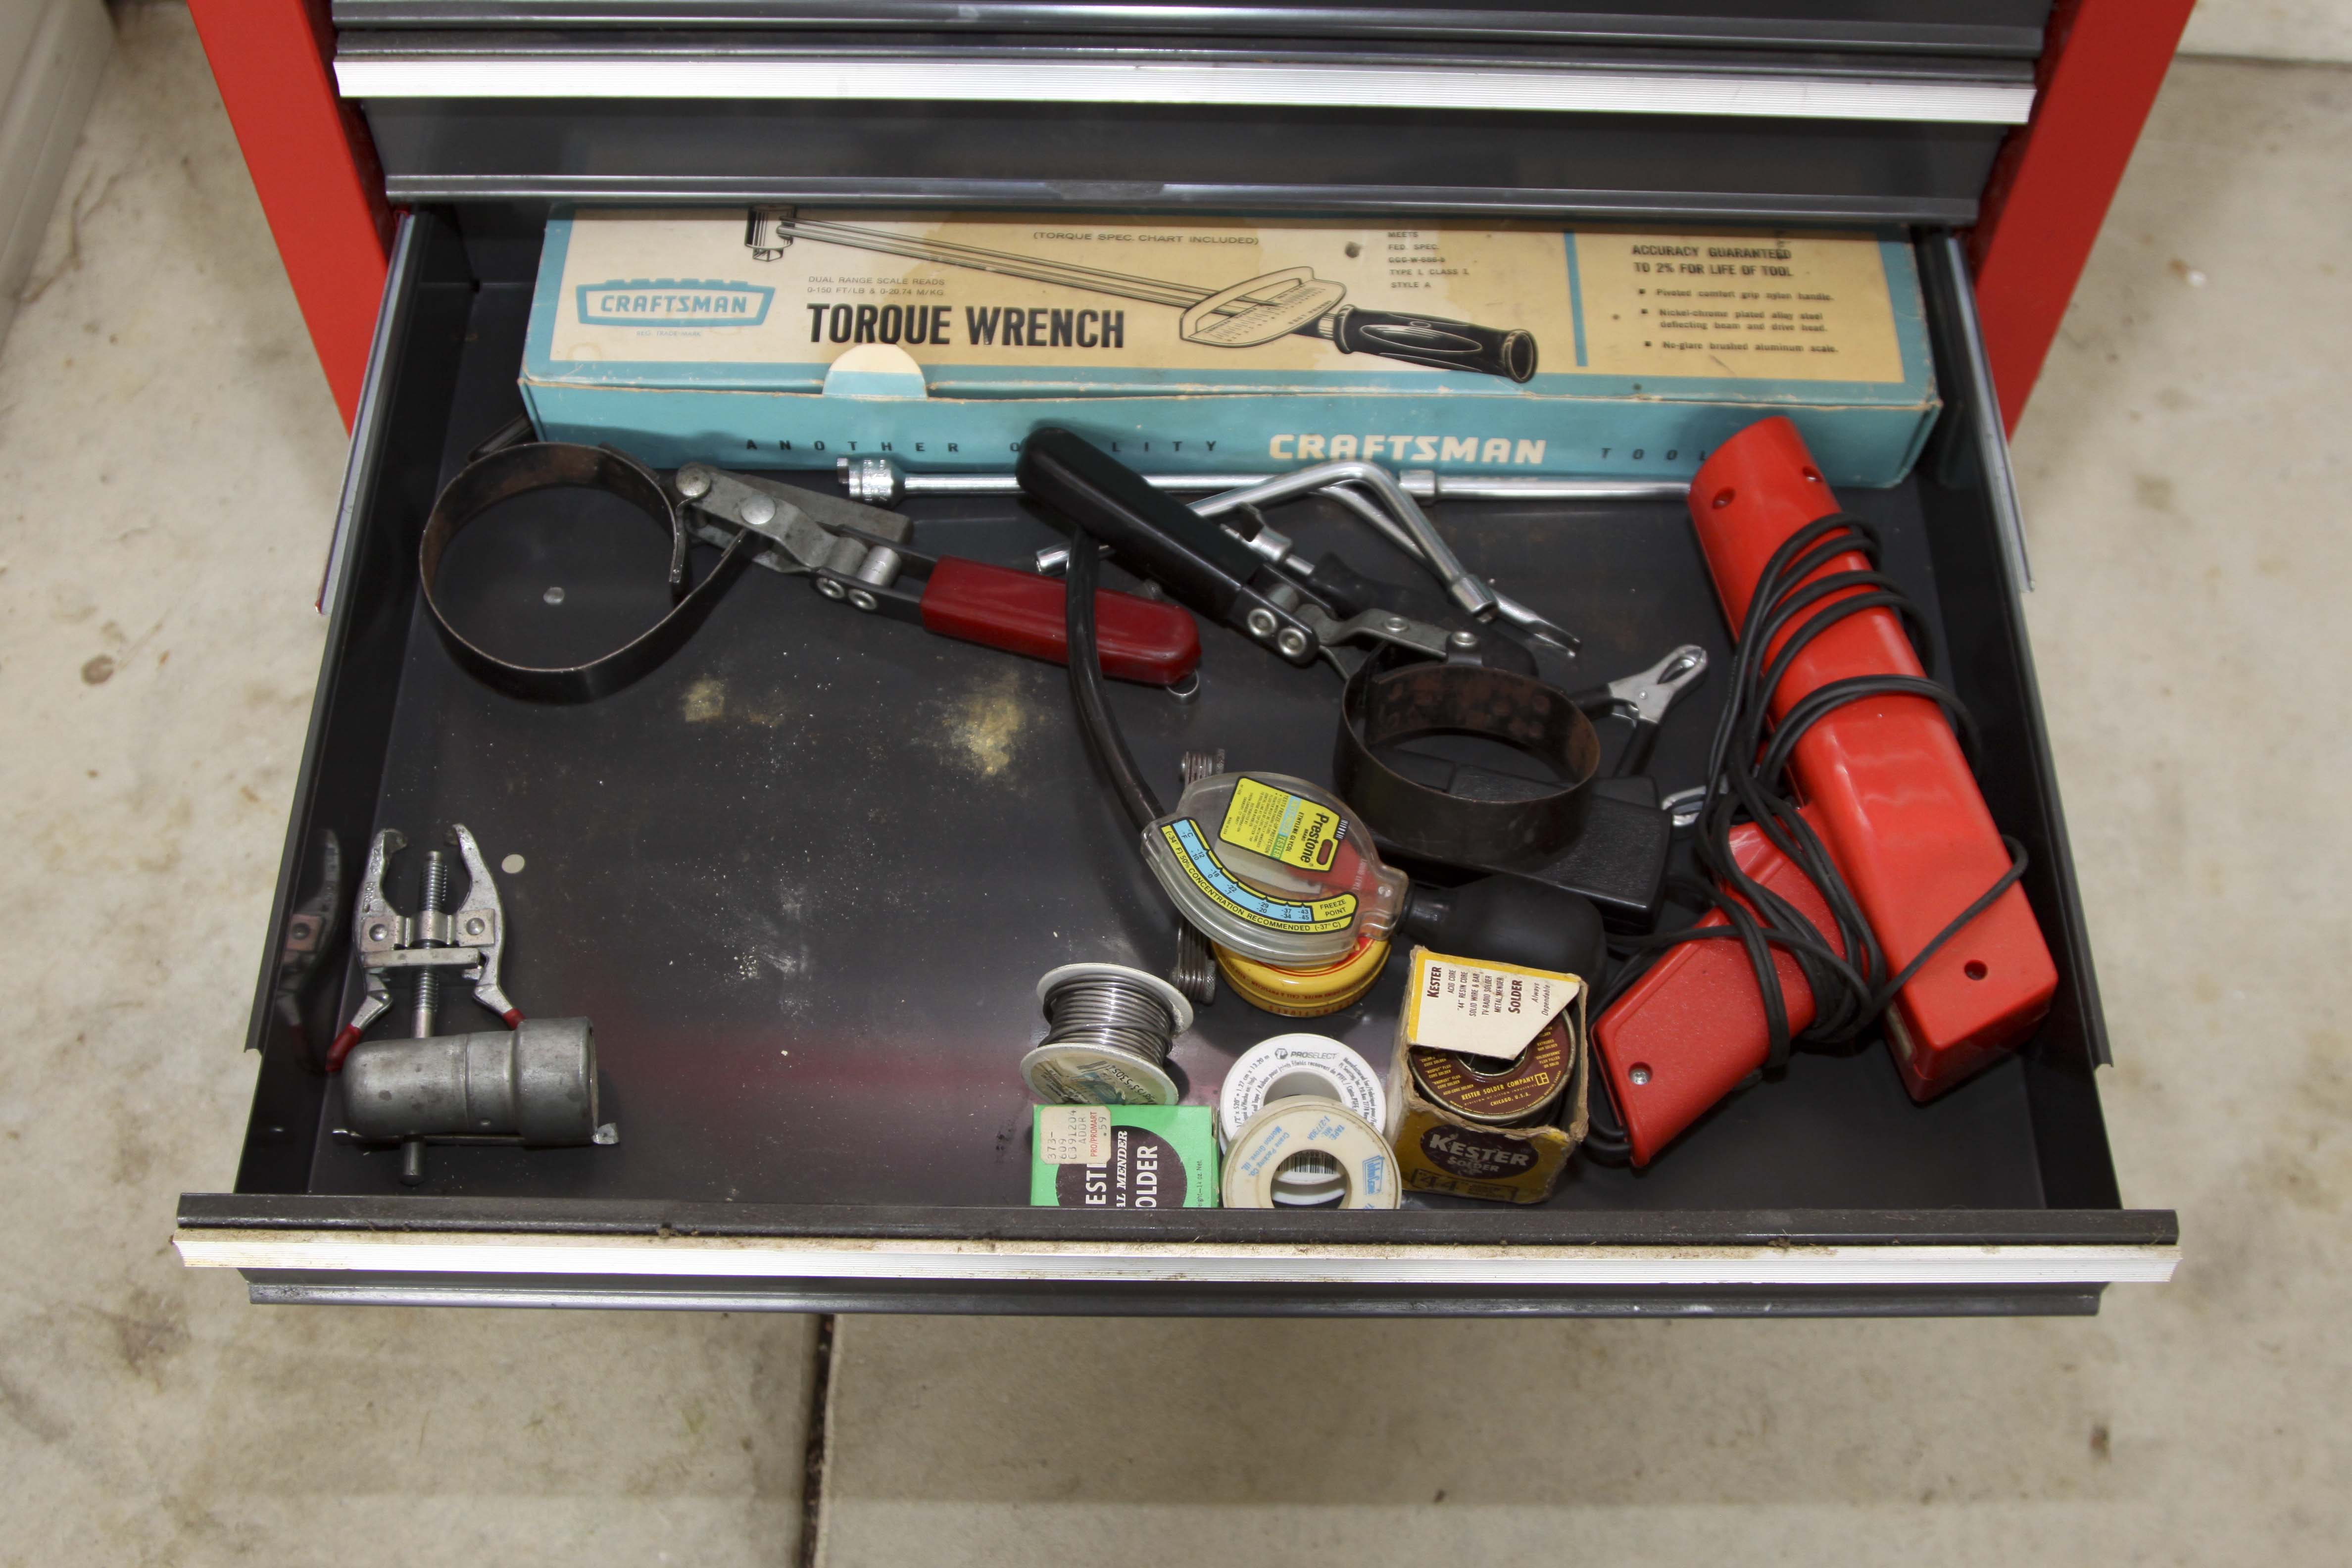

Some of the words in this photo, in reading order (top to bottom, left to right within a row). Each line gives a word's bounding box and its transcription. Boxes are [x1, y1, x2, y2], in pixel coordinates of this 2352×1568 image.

[1033, 232, 1092, 240] (TORQUE
[1138, 235, 1184, 243] CHART
[1189, 236, 1259, 245] INCLUDED)
[1632, 245, 1700, 256] ACCURACY
[1709, 247, 1792, 259] GUARANTEED
[1634, 262, 1651, 272] TO
[1656, 263, 1675, 273] 2%
[1679, 263, 1704, 274] FOR
[1710, 264, 1736, 275] LIFE
[1741, 265, 1757, 275] OF
[600, 295, 748, 313] CRAFTSMAN
[1656, 288, 1692, 297] Pivoted
[1741, 291, 1761, 300] grip
[1766, 292, 1792, 300] nylon
[1659, 309, 1728, 318] Nickel-chrome
[1735, 311, 1765, 319] plated
[1771, 312, 1793, 320] alloy
[807, 303, 952, 344] TORQUE
[966, 305, 1125, 348] WRENCH
[1660, 321, 1708, 330] deflecting
[1710, 342, 1749, 350] brushed
[1755, 343, 1804, 352] aluminum
[746, 439, 959, 452] ANOTHER
[1010, 440, 1218, 452] QLITY
[1269, 434, 1546, 464] CRAFTSMAN
[1292, 811, 1304, 834] ETHYLENE
[1264, 829, 1276, 854] PROTECTION
[1273, 835, 1285, 858] TESTER
[1285, 834, 1296, 852] GLYCOL
[1300, 812, 1329, 865] Prestone
[1211, 869, 1220, 878] -18
[1226, 884, 1237, 892] -22
[1180, 855, 1191, 868] 50%
[1188, 868, 1245, 916] CONCENTRATION
[1246, 913, 1310, 931] RECOMMENDED
[1320, 898, 1347, 910] FREEZE
[1325, 907, 1347, 917] POINT
[1427, 967, 1442, 998] KESTER
[1496, 977, 1505, 996] MENDER
[1531, 982, 1540, 1003] Always
[1482, 993, 1491, 1016] TV-RADIO
[1494, 995, 1503, 1013] METAL
[1508, 980, 1523, 1014] SOLDER
[1541, 984, 1551, 1016] Dependable
[1469, 1003, 1478, 1017] SOLID
[1290, 1051, 1338, 1060] PROSELECT
[1461, 1090, 1481, 1100] KESTER
[1483, 1084, 1505, 1095] SOLDER
[1507, 1076, 1535, 1088] COMPANY
[1490, 1096, 1514, 1107] CHICAGO,
[1090, 1111, 1098, 1157] PRO/PROMART
[1098, 1116, 1108, 1137] .59
[1047, 1131, 1057, 1160] 373-
[1059, 1138, 1067, 1160] 609
[1429, 1134, 1530, 1166] KESTER
[1117, 1130, 1128, 1190] MENDER
[1447, 1156, 1500, 1173] SOLDER
[1135, 1145, 1158, 1208] OLDER
